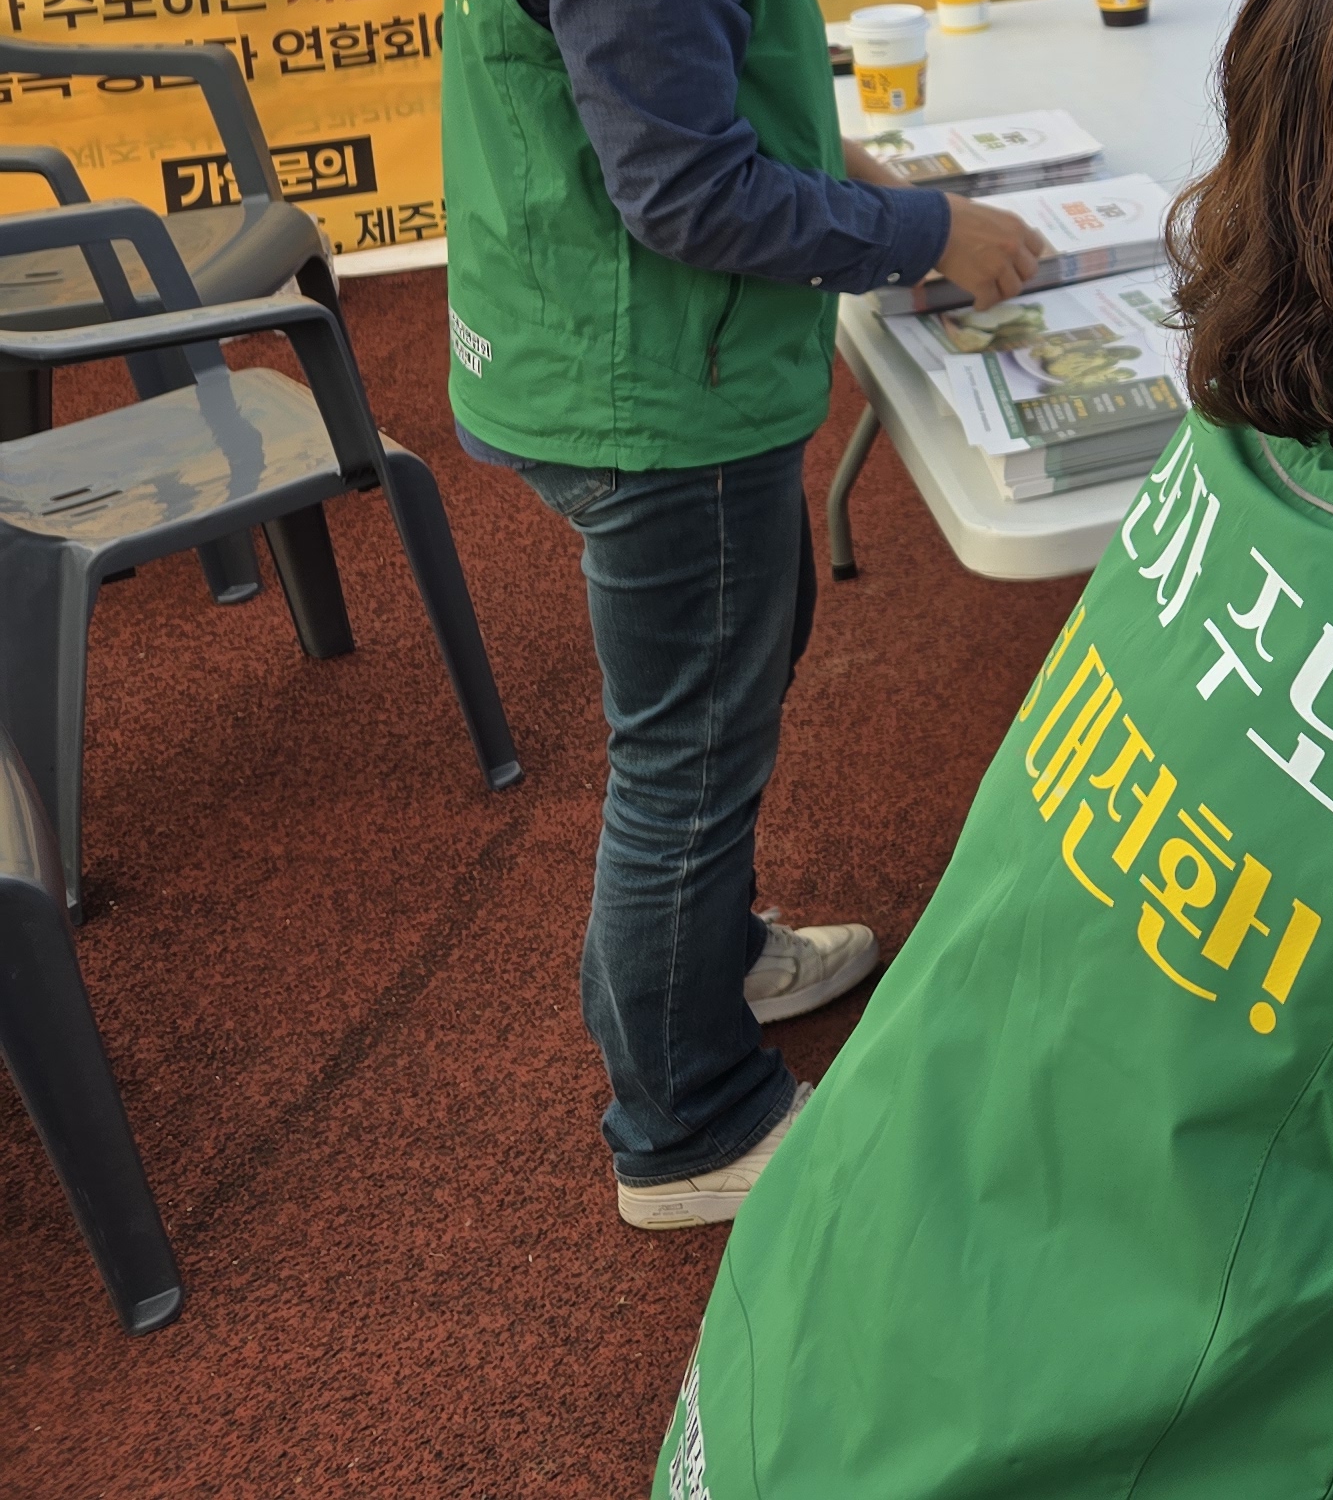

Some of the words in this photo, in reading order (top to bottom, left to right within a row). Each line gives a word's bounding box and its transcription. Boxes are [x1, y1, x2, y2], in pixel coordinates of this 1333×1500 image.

[272, 11, 445, 75] 연합회
[177, 145, 360, 209] 가문의
[353, 197, 447, 249] 제주
[1024, 641, 1323, 1035] 대전환!
